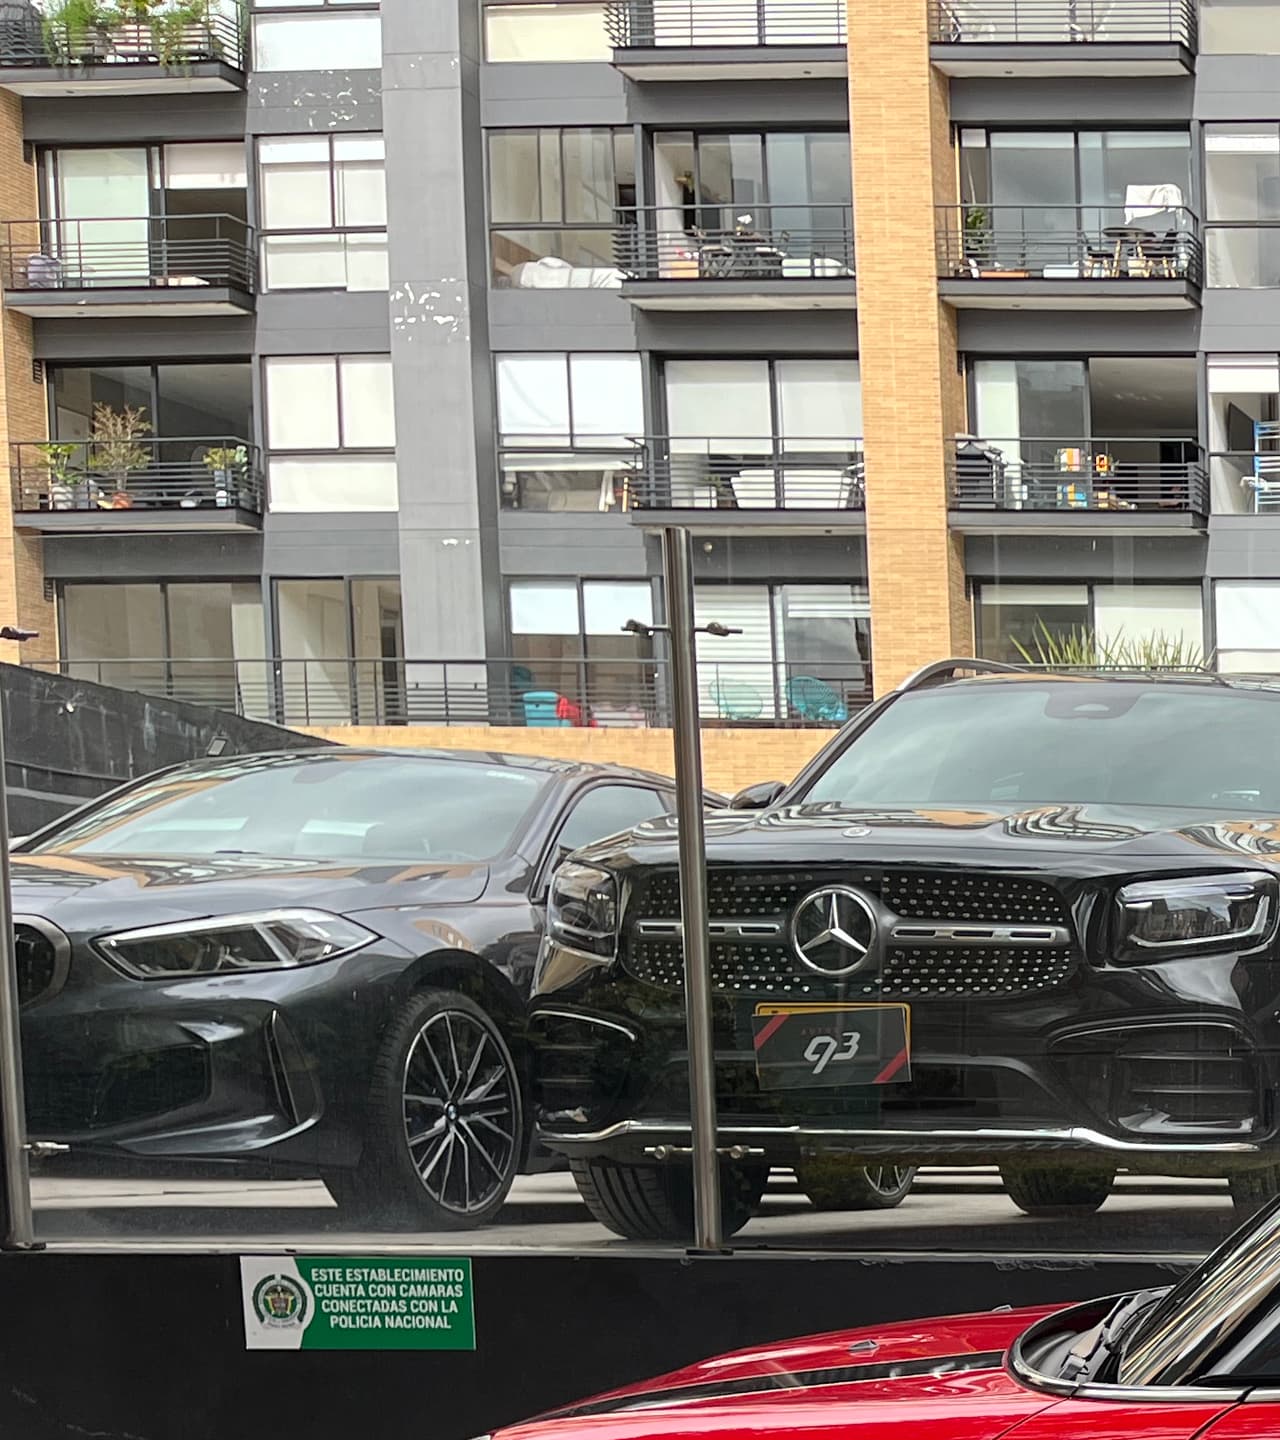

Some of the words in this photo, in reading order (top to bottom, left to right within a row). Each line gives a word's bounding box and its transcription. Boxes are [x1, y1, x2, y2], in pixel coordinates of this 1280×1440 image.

[311, 1268, 343, 1282] ESTE
[345, 1268, 464, 1282] ESTABLECIMIENTO
[314, 1284, 366, 1297] CUENTA
[368, 1284, 396, 1297] CON
[399, 1284, 463, 1298] CAMARAS
[321, 1299, 408, 1313] CONECTADAS
[410, 1300, 438, 1313] CON
[441, 1300, 458, 1313] LA
[330, 1315, 382, 1329] POLICIA
[385, 1315, 452, 1329] NACIONAL
